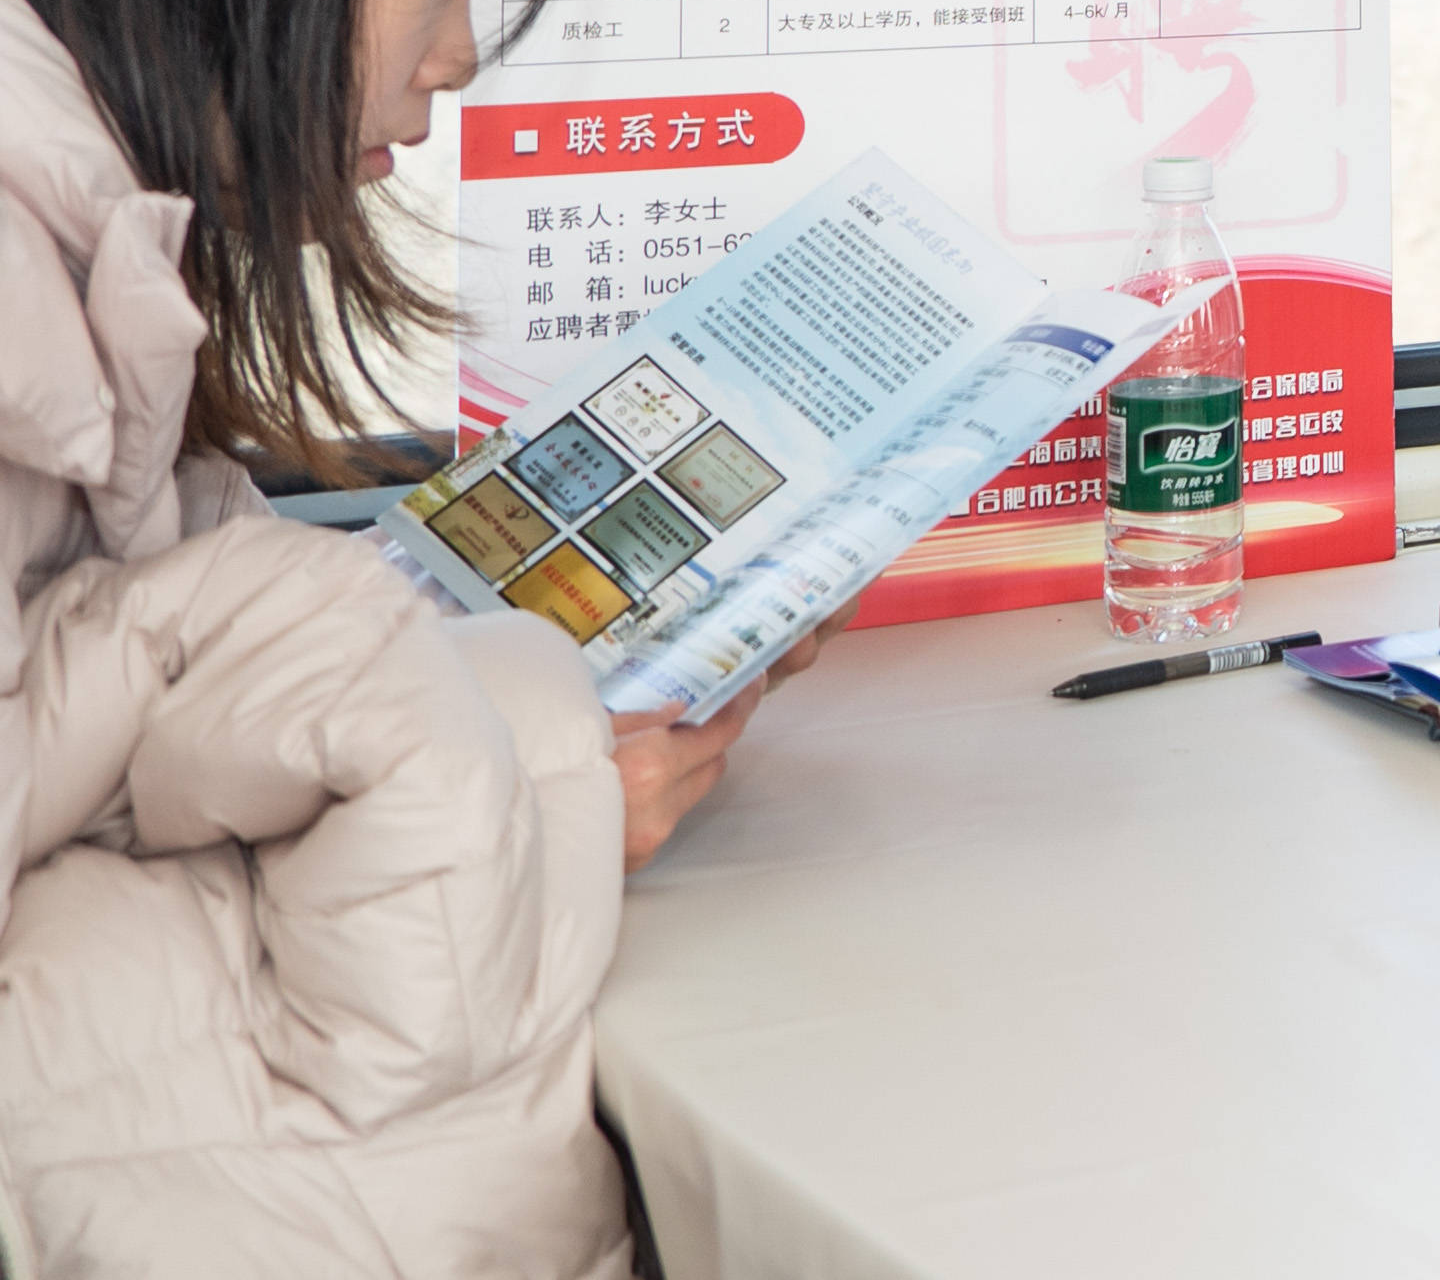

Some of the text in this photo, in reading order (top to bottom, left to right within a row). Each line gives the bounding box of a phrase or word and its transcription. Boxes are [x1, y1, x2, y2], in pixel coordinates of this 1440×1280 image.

[562, 21, 624, 41] 质检工
[720, 19, 730, 33] 2
[777, 6, 1026, 32] 大专及以上学历，能接受倒班
[565, 109, 757, 155] 联系方式
[1243, 368, 1343, 400] 会保障局
[1243, 409, 1344, 442] 肥客运段
[1243, 450, 1344, 484] 管理中心
